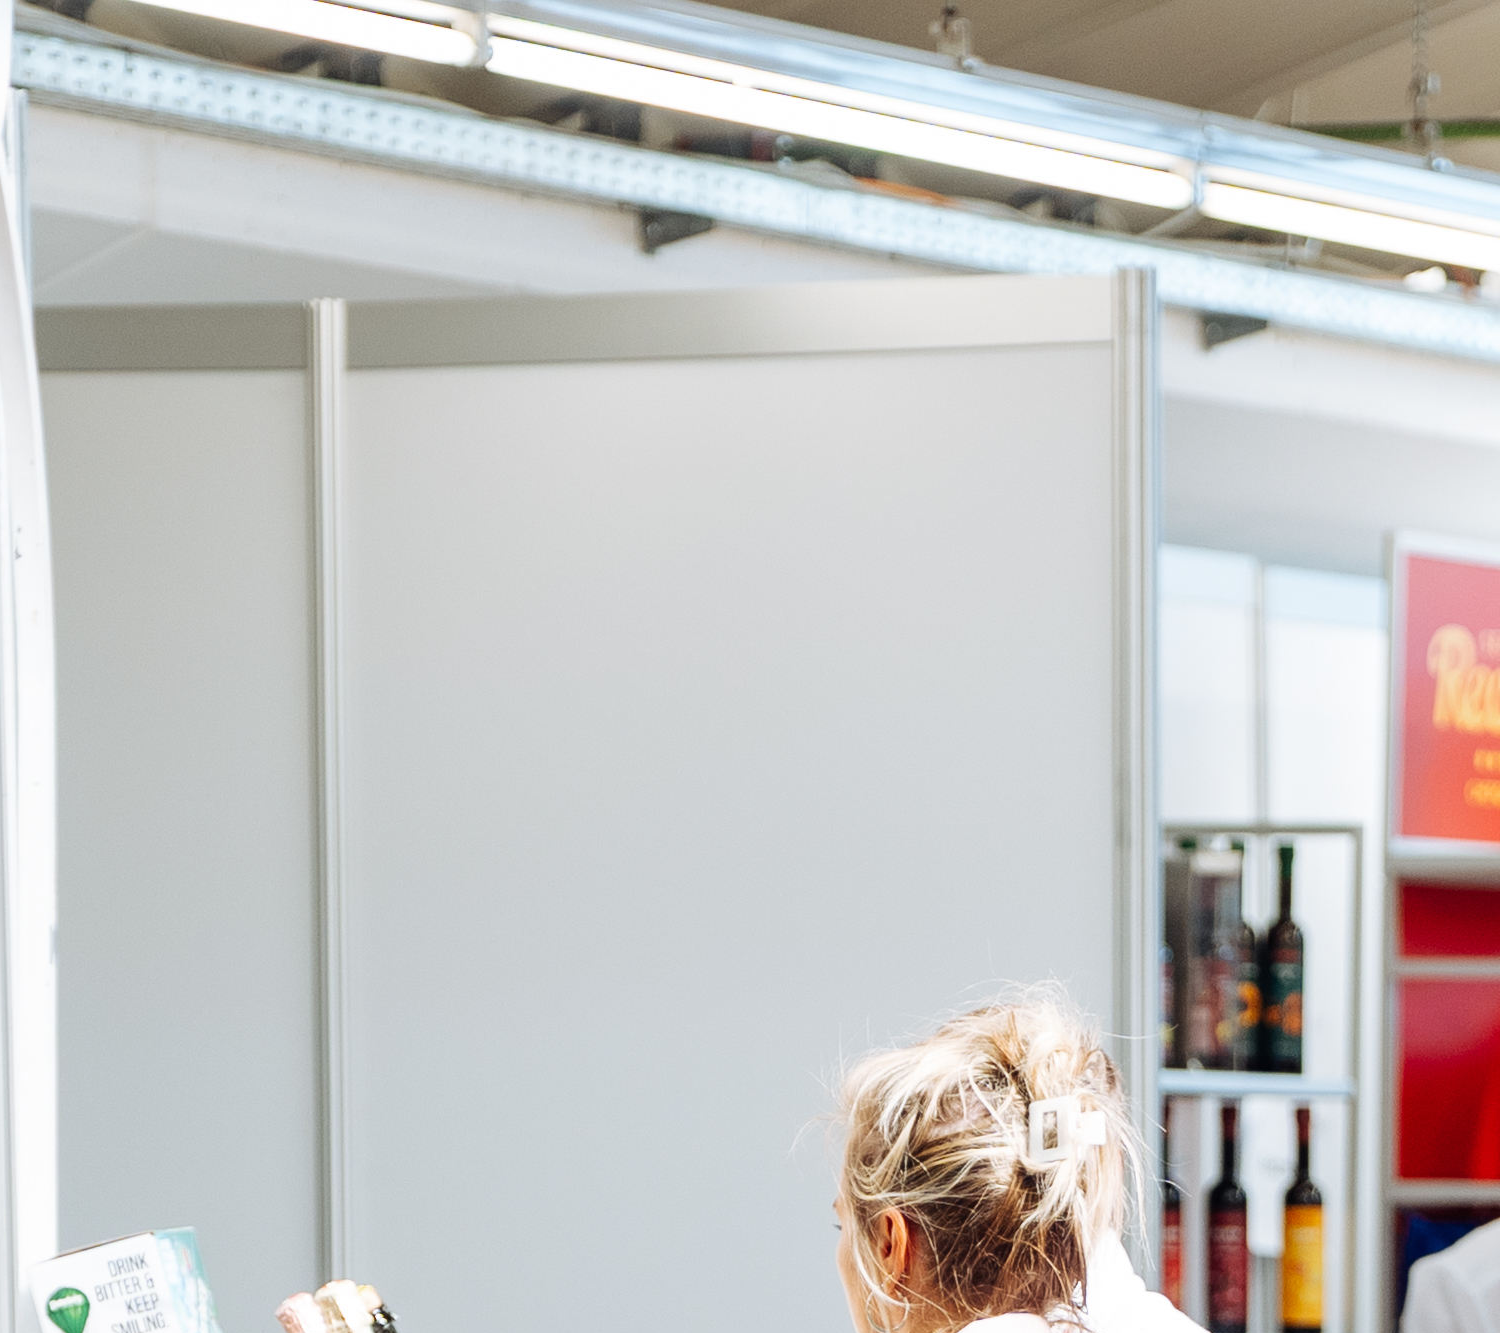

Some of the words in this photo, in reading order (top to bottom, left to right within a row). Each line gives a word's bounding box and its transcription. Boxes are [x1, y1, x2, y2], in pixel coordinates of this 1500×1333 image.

[107, 1253, 149, 1278] DRINK
[94, 1278, 143, 1302] BITTER
[125, 1293, 159, 1316] KEEP
